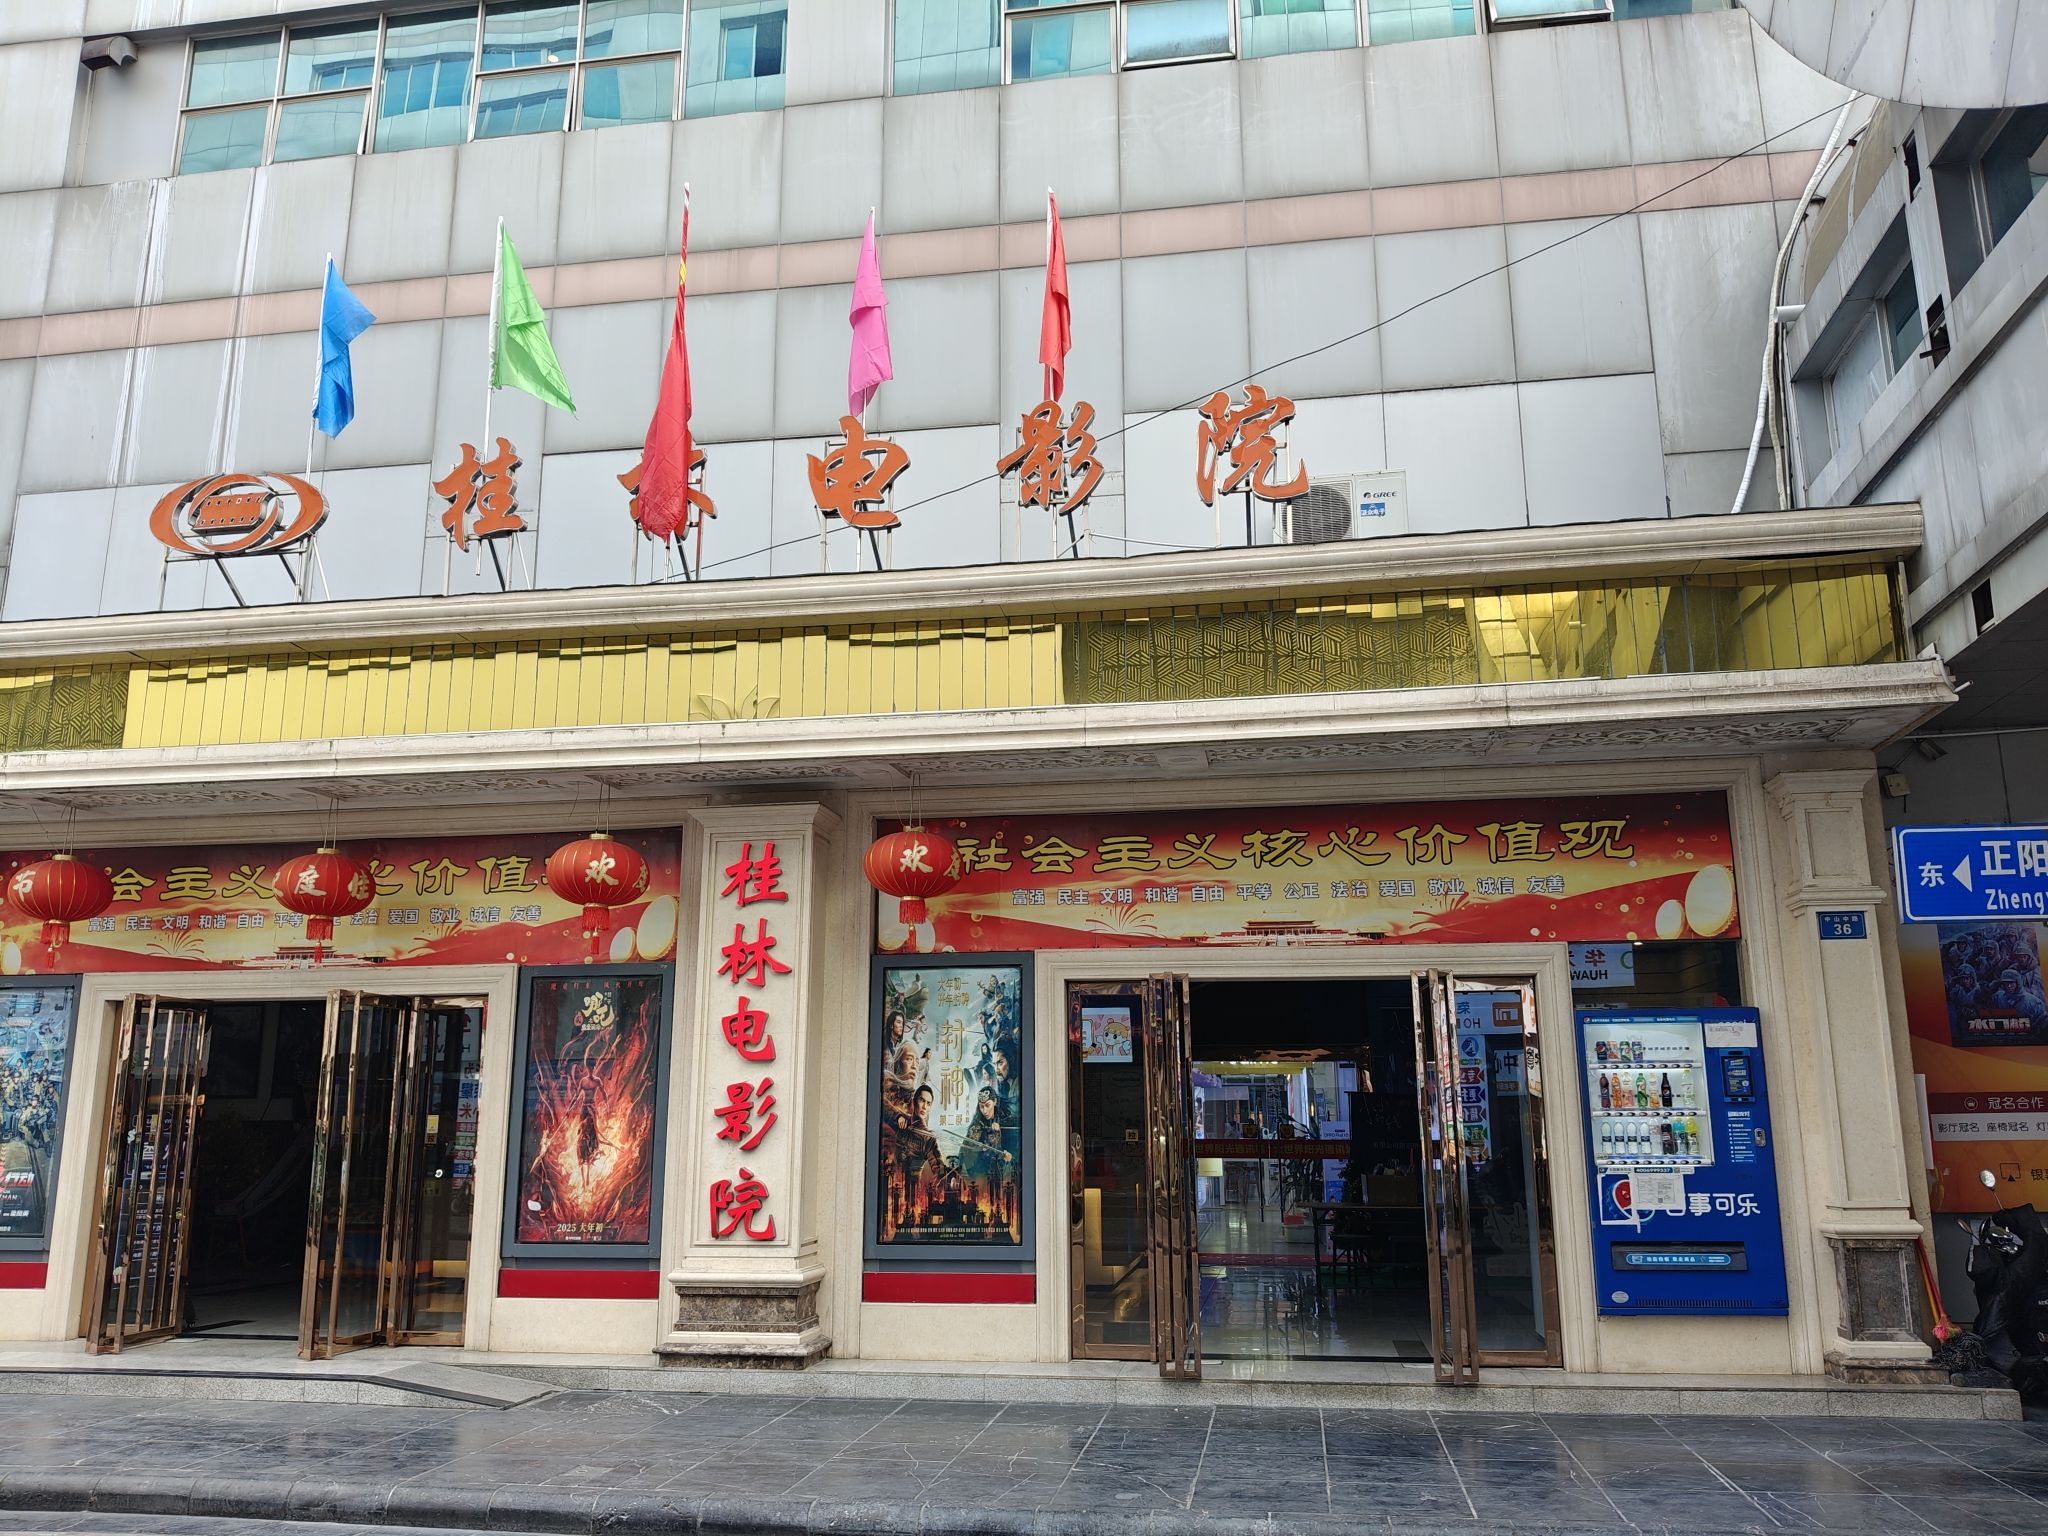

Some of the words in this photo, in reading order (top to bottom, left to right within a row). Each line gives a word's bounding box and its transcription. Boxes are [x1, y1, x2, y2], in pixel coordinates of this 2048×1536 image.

[433, 384, 1310, 552] 桂电影院
[957, 820, 1634, 876] 社会主义核心价值观
[1981, 841, 2048, 877] 正阳
[12, 869, 37, 901] 节
[1918, 862, 1945, 887] 东
[1012, 888, 1046, 906] 富强
[1056, 888, 1090, 905] 民主
[1100, 888, 1133, 904] 文明
[1145, 886, 1179, 903] 和谐
[1191, 884, 1225, 901] 自由
[1237, 883, 1272, 900] 平等
[1283, 883, 1319, 899] 公正
[1331, 880, 1369, 898] 法治
[1379, 879, 1416, 897] 爱国
[1428, 878, 1465, 896] 敬业
[1477, 877, 1515, 894] 诚信
[1527, 875, 1565, 893] 友善
[88, 916, 116, 932] 富强
[125, 916, 152, 931] 民主
[161, 915, 189, 930] 文明
[199, 915, 227, 930] 和谐
[236, 914, 264, 929] 自由
[388, 909, 419, 925] 爱国
[429, 908, 460, 924] 敬业
[470, 907, 501, 923] 诚信
[510, 905, 542, 922] 友善
[1833, 923, 1852, 935] 36
[710, 841, 793, 1241] 桂林电影院
[939, 1018, 964, 1111] 封神
[1988, 1097, 2045, 1110] 冠名合作
[1938, 1122, 1980, 1133] 影厅冠名
[1987, 1122, 2029, 1132] 座椅冠名
[2036, 1122, 2048, 1132] 灯
[5, 1171, 35, 1187] 行动
[1665, 1193, 1761, 1216] 事可乐
[557, 1223, 577, 1232] 2025
[579, 1222, 612, 1233] 大年初一
